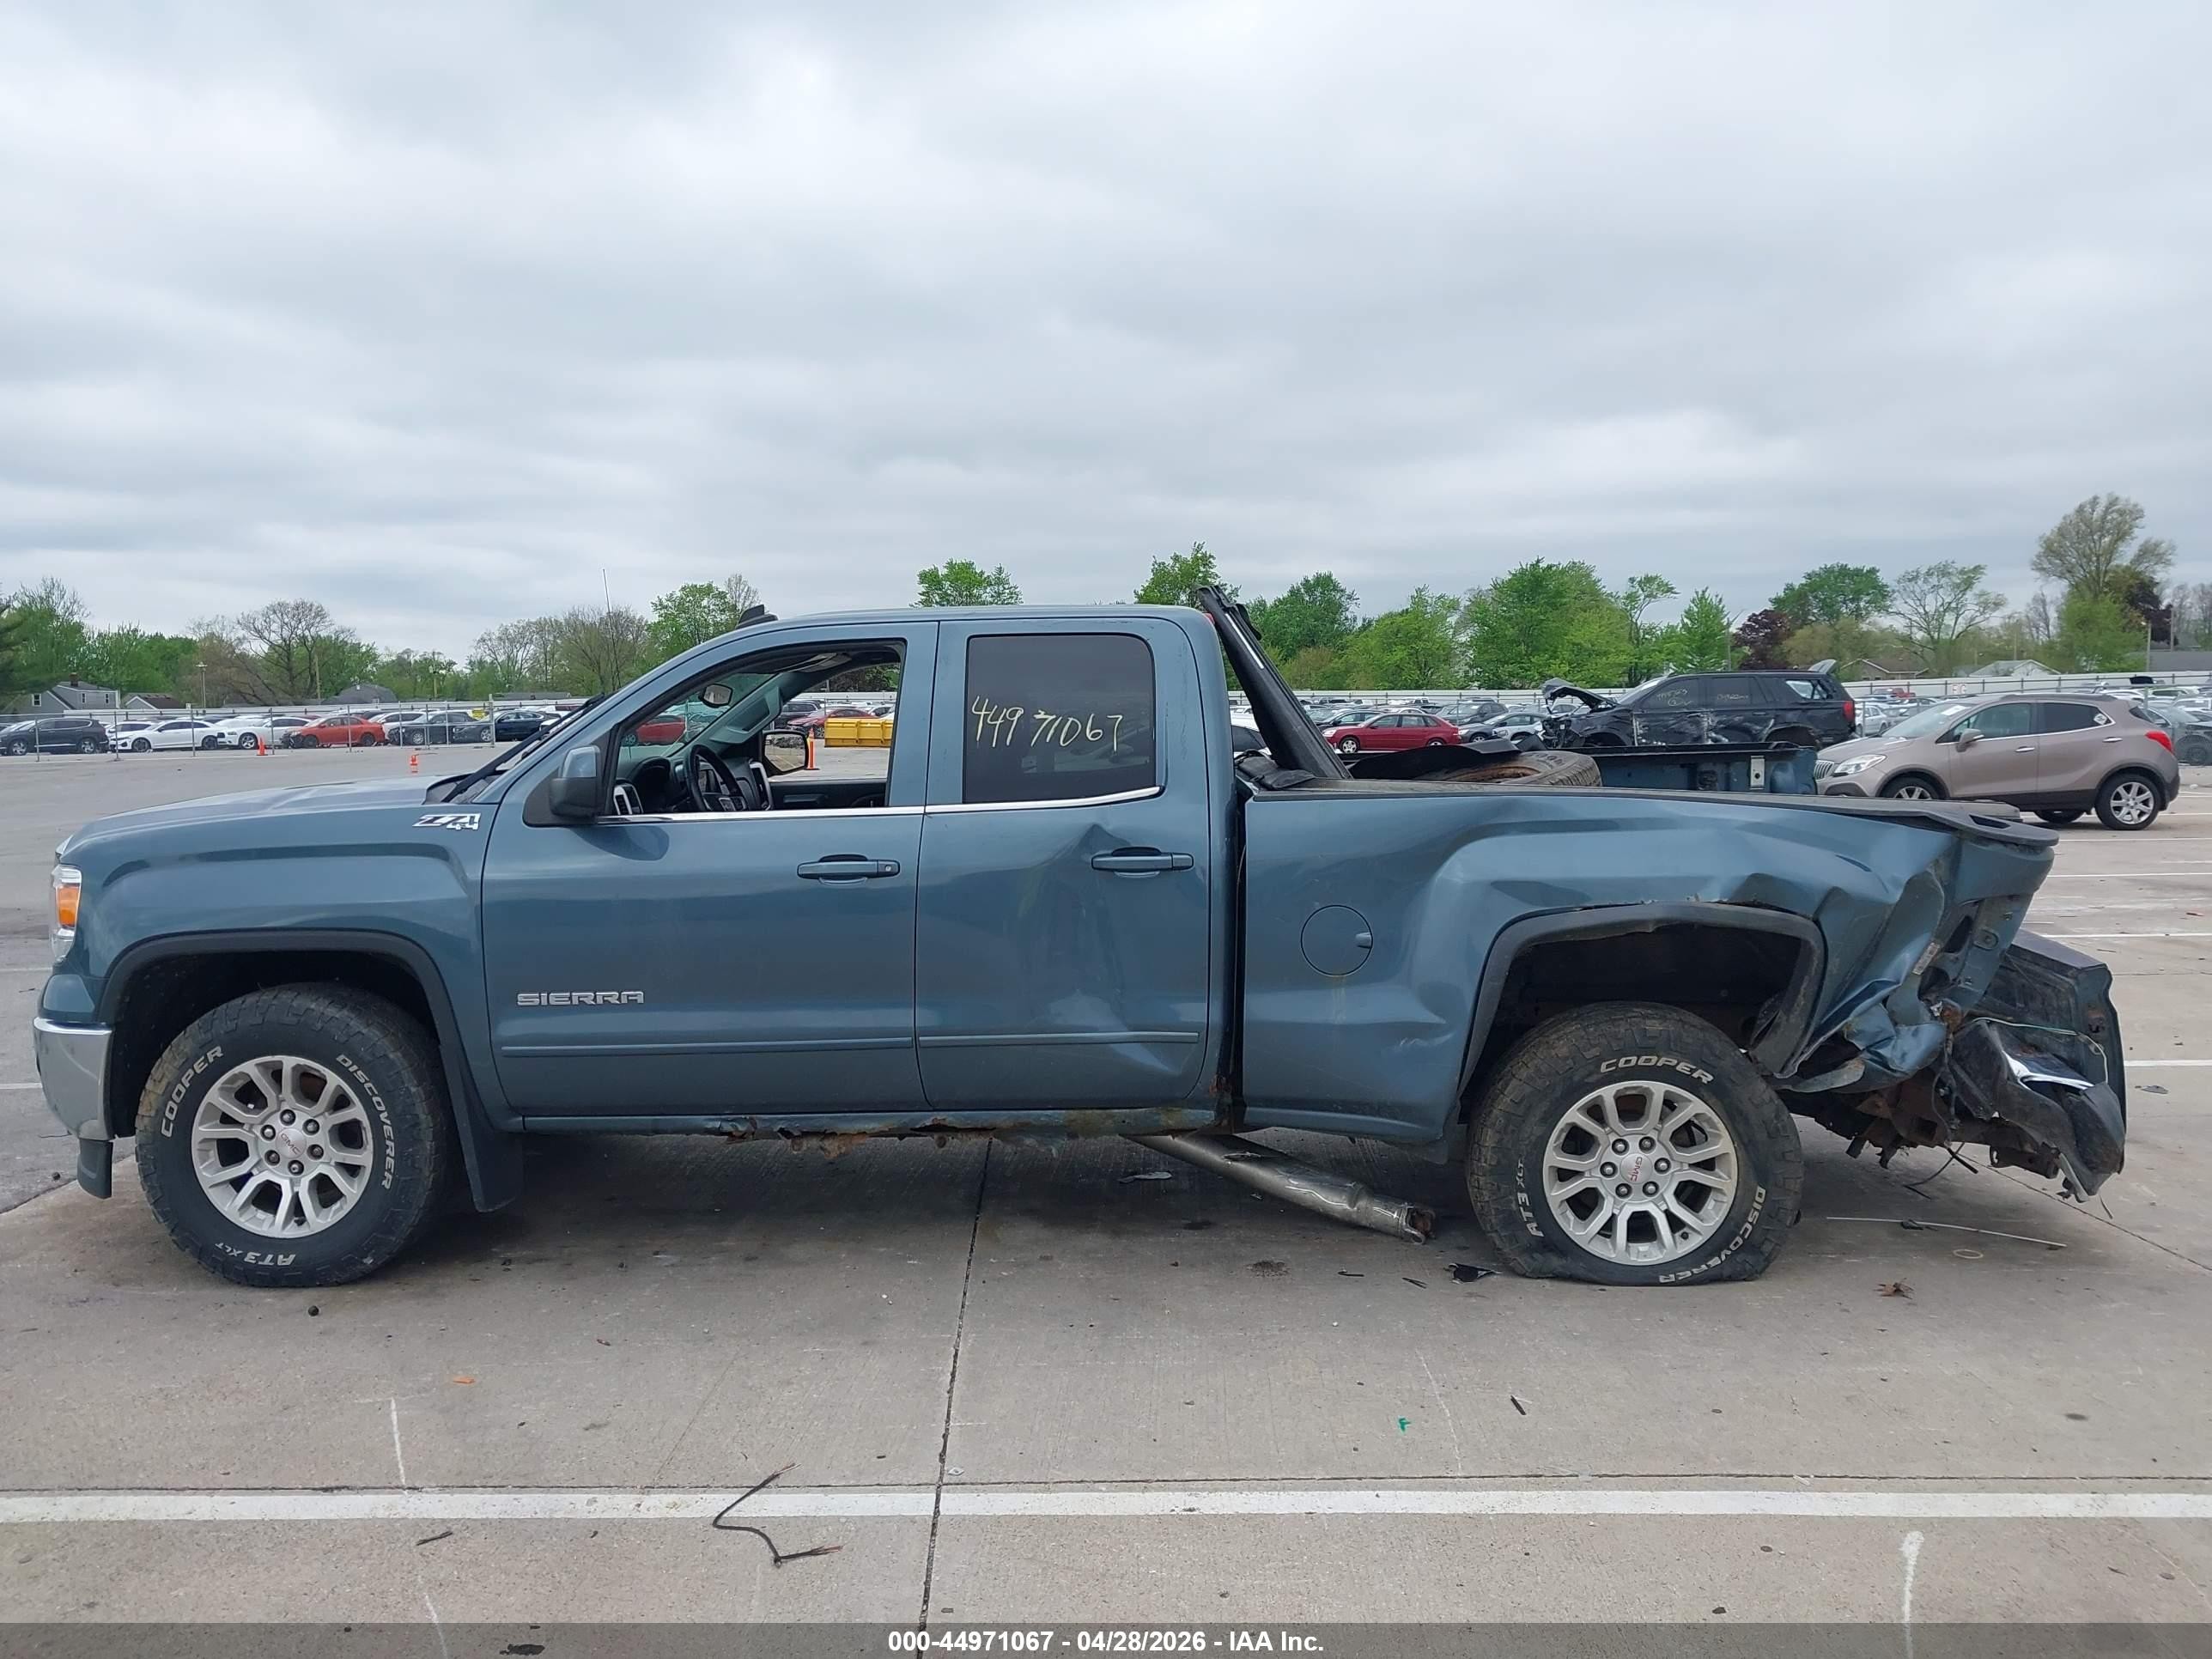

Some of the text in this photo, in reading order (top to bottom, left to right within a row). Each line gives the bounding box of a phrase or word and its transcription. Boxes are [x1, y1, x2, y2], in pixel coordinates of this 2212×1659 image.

[517, 991, 644, 1006] SIERRA
[1600, 1055, 1715, 1085] COOPER
[161, 1046, 224, 1138] COOPER
[336, 1054, 396, 1190] DISCOVERER
[281, 1133, 301, 1156] GMC
[1630, 1156, 1643, 1182] GMC
[1517, 1192, 1545, 1237] AT3
[1658, 1185, 1767, 1284] DISCOVERER
[243, 1251, 296, 1267] AT3
